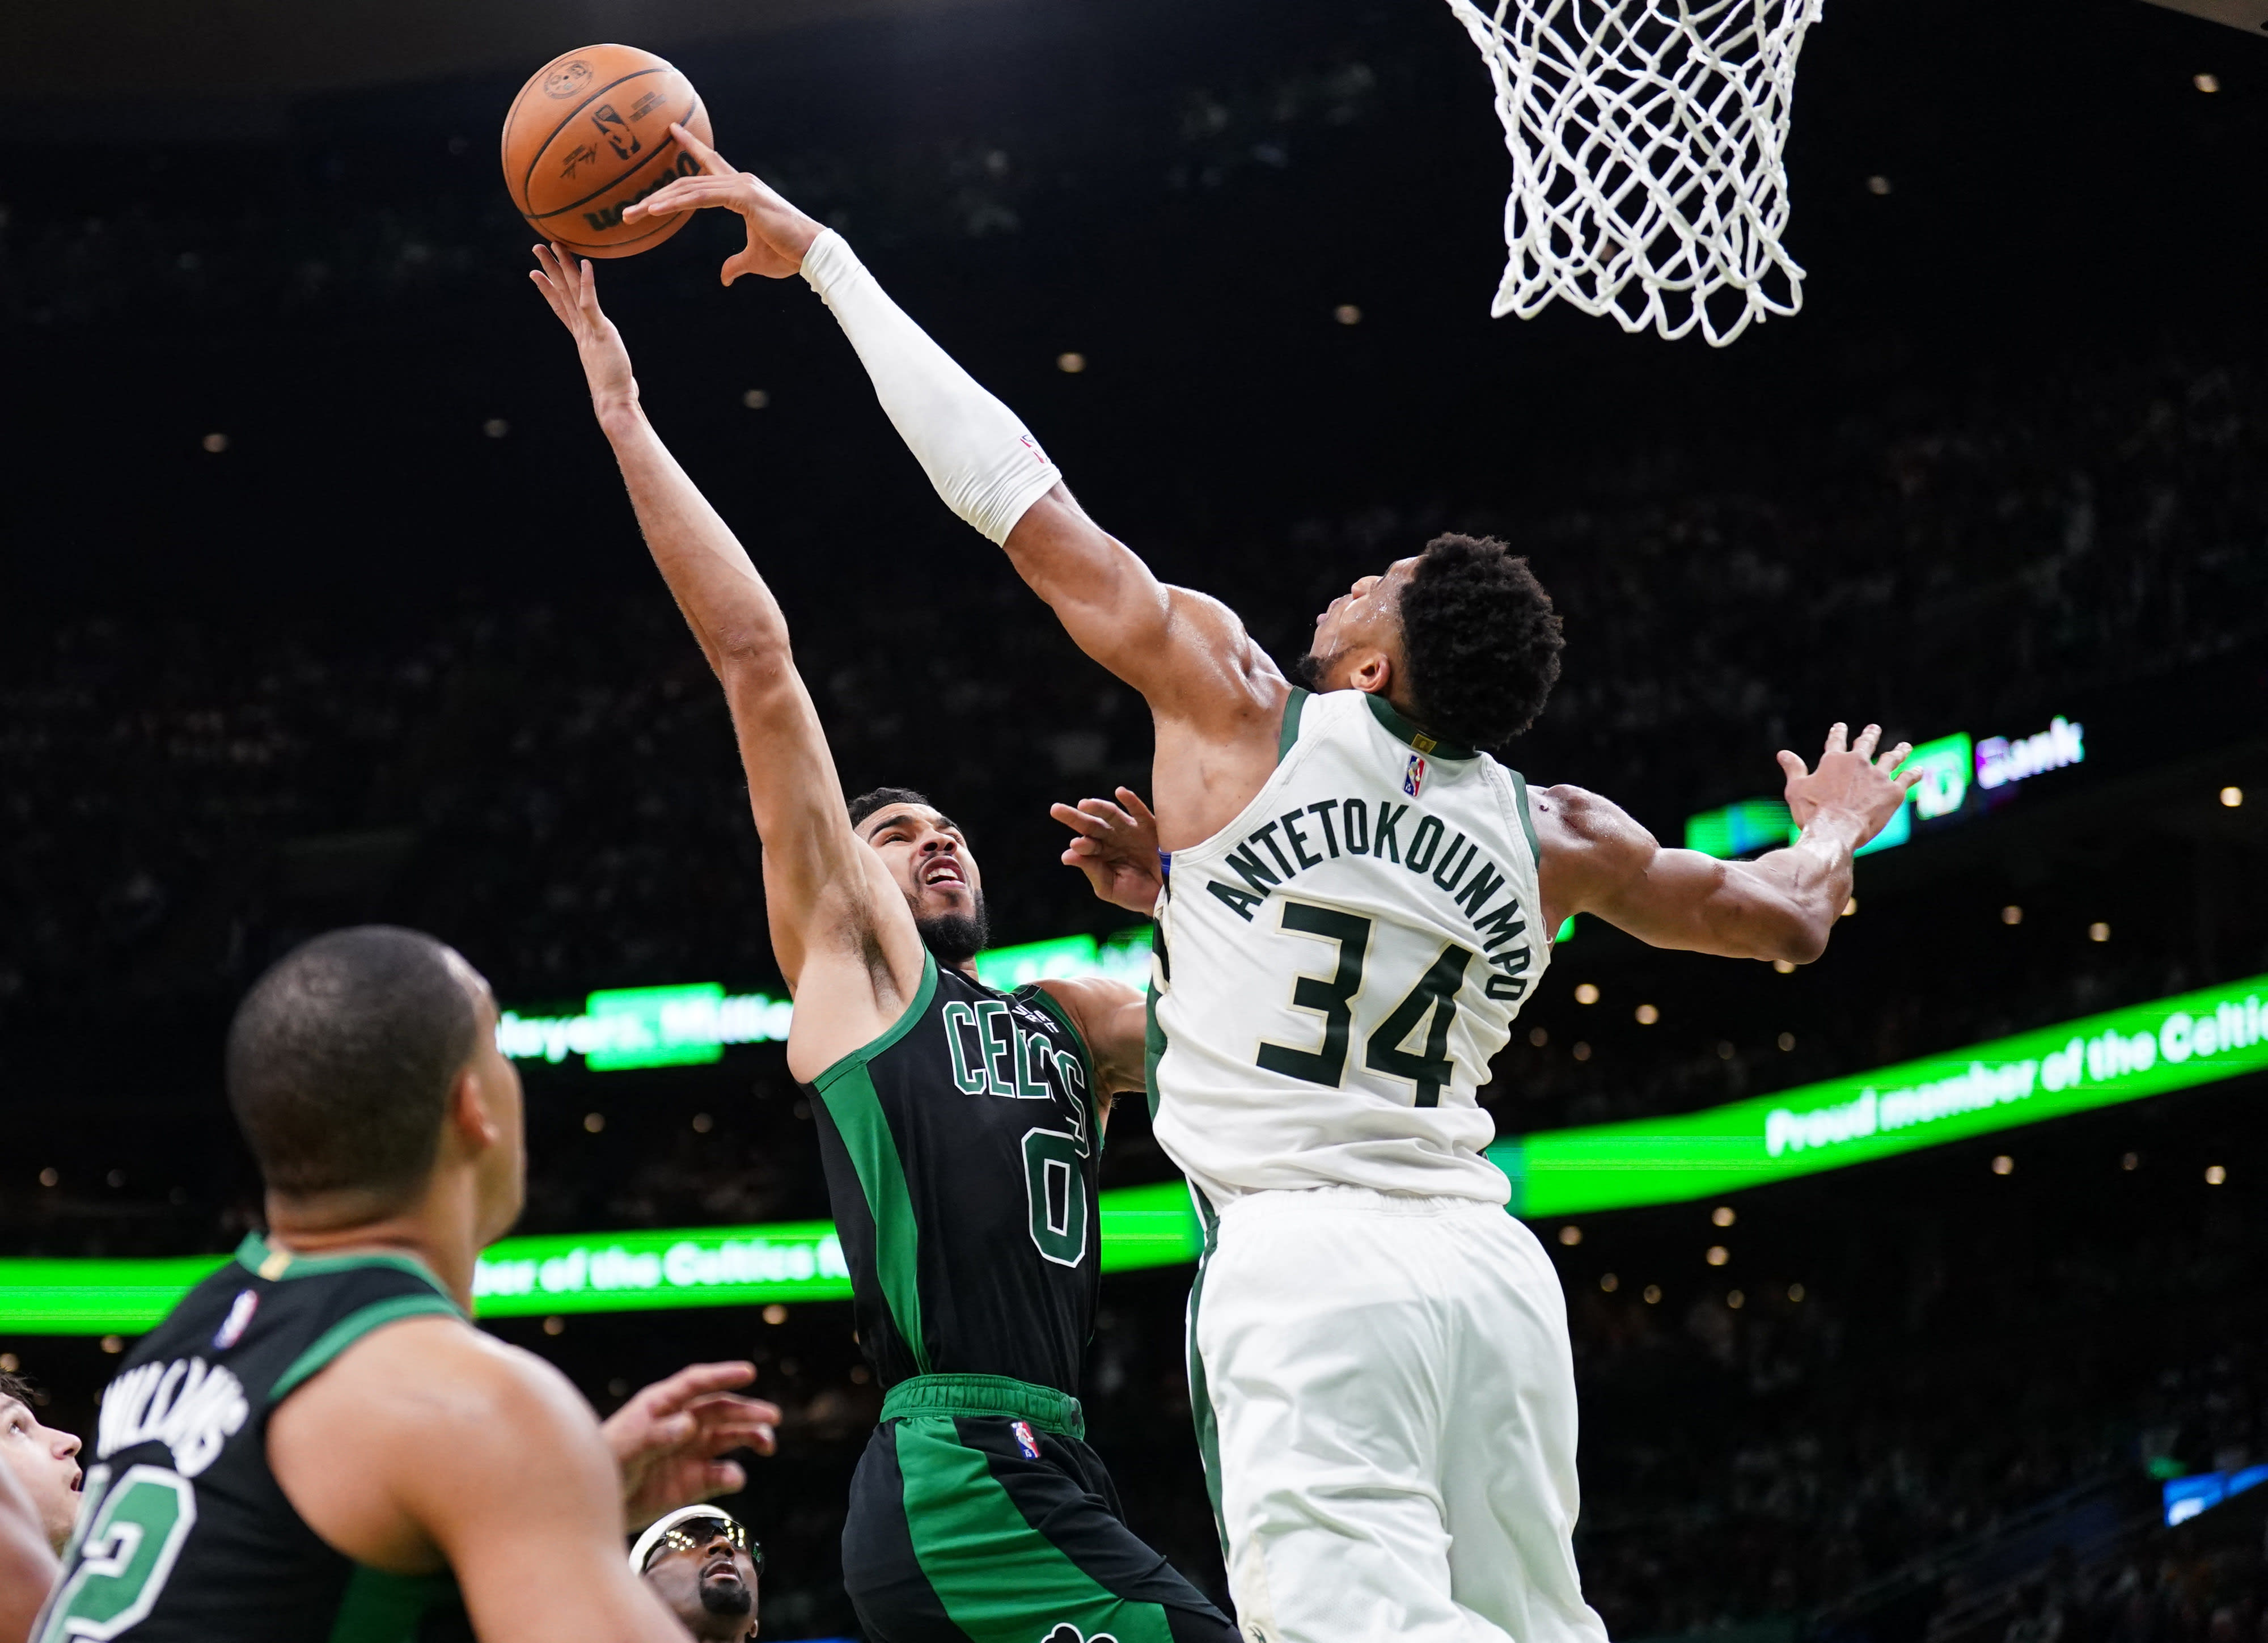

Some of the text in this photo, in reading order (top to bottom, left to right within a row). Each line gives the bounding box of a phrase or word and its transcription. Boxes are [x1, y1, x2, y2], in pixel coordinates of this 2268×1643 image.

[1205, 798, 1530, 1000] ANTETOKOUNMPO
[1255, 896, 1474, 1108] 34
[1765, 1086, 1877, 1157] Proud
[1878, 1059, 2038, 1131] member
[2041, 1037, 2085, 1092] of
[2087, 1028, 2156, 1082] the
[539, 1247, 588, 1293] of
[589, 1242, 663, 1291] the
[663, 1238, 815, 1288] Celtics
[1021, 1127, 1088, 1268] 0
